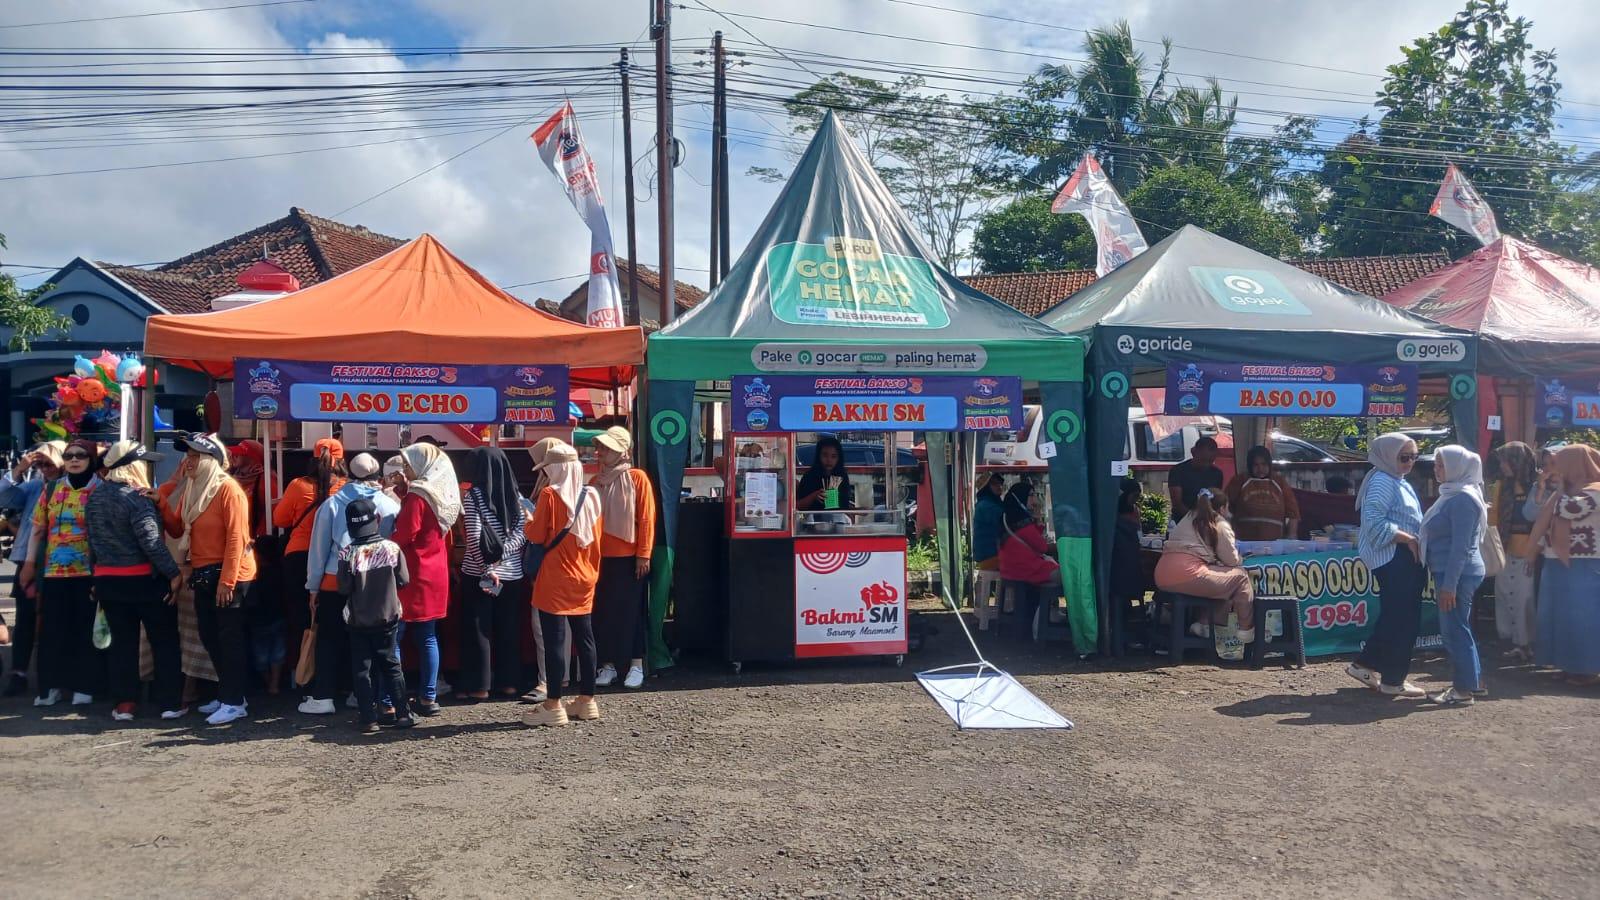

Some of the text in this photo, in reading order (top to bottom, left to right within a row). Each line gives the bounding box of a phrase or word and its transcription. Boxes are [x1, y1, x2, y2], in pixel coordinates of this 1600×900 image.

[800, 281, 913, 307] HEMAT
[1231, 296, 1288, 306] gojek
[1138, 336, 1193, 354] goride
[1418, 342, 1459, 358] gojek
[761, 350, 977, 366] Pake gocar HEMAT paling hemat
[330, 365, 458, 384] FESTIVAL BAKSO 3
[1241, 365, 1336, 381] FESTIVAL BAKSO 3
[814, 377, 923, 394] FESTIVAL BAKSO 3
[319, 391, 468, 414] BASO ECHO
[1239, 389, 1337, 408] BASO OJO
[504, 407, 556, 422] AIDA
[812, 403, 925, 422] BAKMI SM
[1368, 403, 1404, 415] AIDA
[964, 416, 1011, 430] AIDA
[1327, 558, 1368, 595] OJO
[801, 606, 898, 625] Bakmi SM
[1305, 602, 1368, 629] 1984
[826, 627, 856, 638] Sarang
